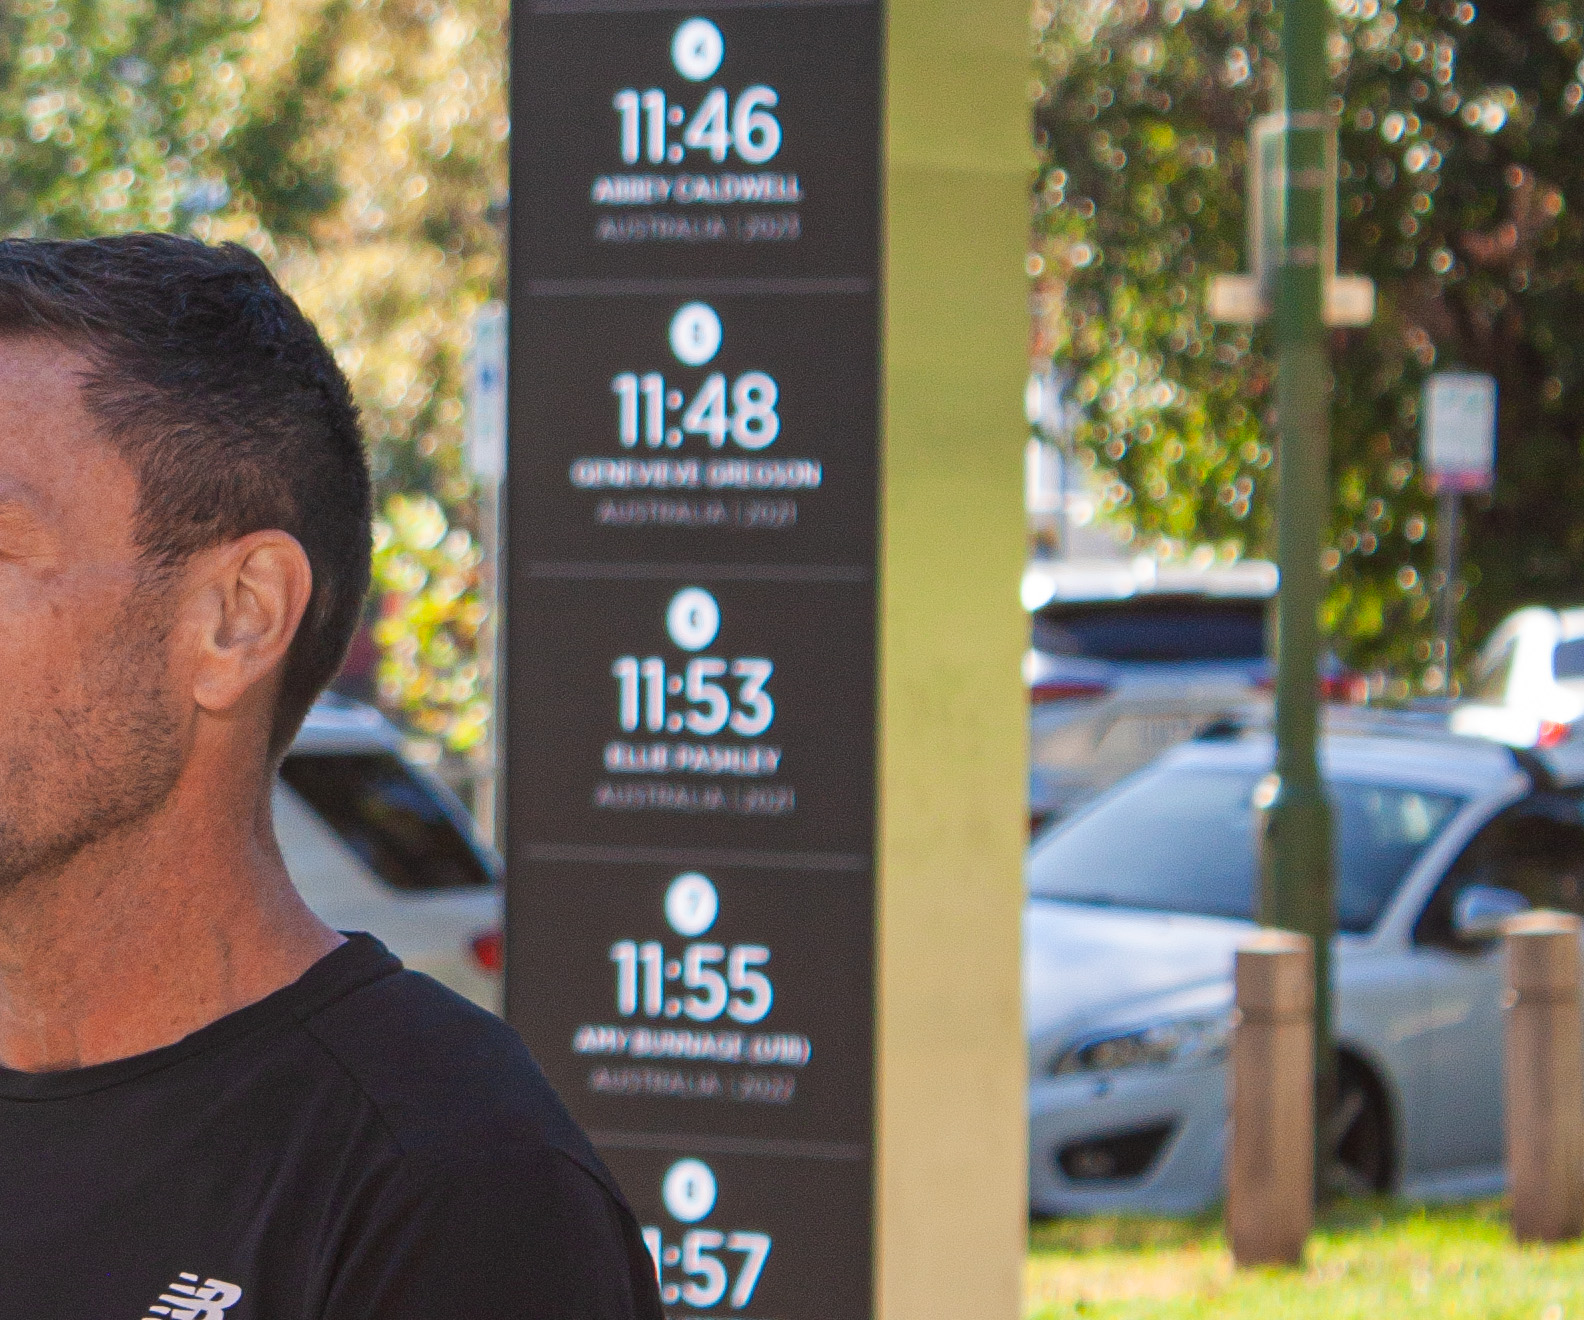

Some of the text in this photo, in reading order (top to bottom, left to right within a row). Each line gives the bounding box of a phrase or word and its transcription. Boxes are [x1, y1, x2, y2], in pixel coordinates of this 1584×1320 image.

[613, 83, 783, 165] 11:46
[610, 369, 781, 450] 11:48
[612, 654, 775, 737] 11:53
[609, 939, 774, 1025] 11:55
[641, 1225, 773, 1310] 1:57
